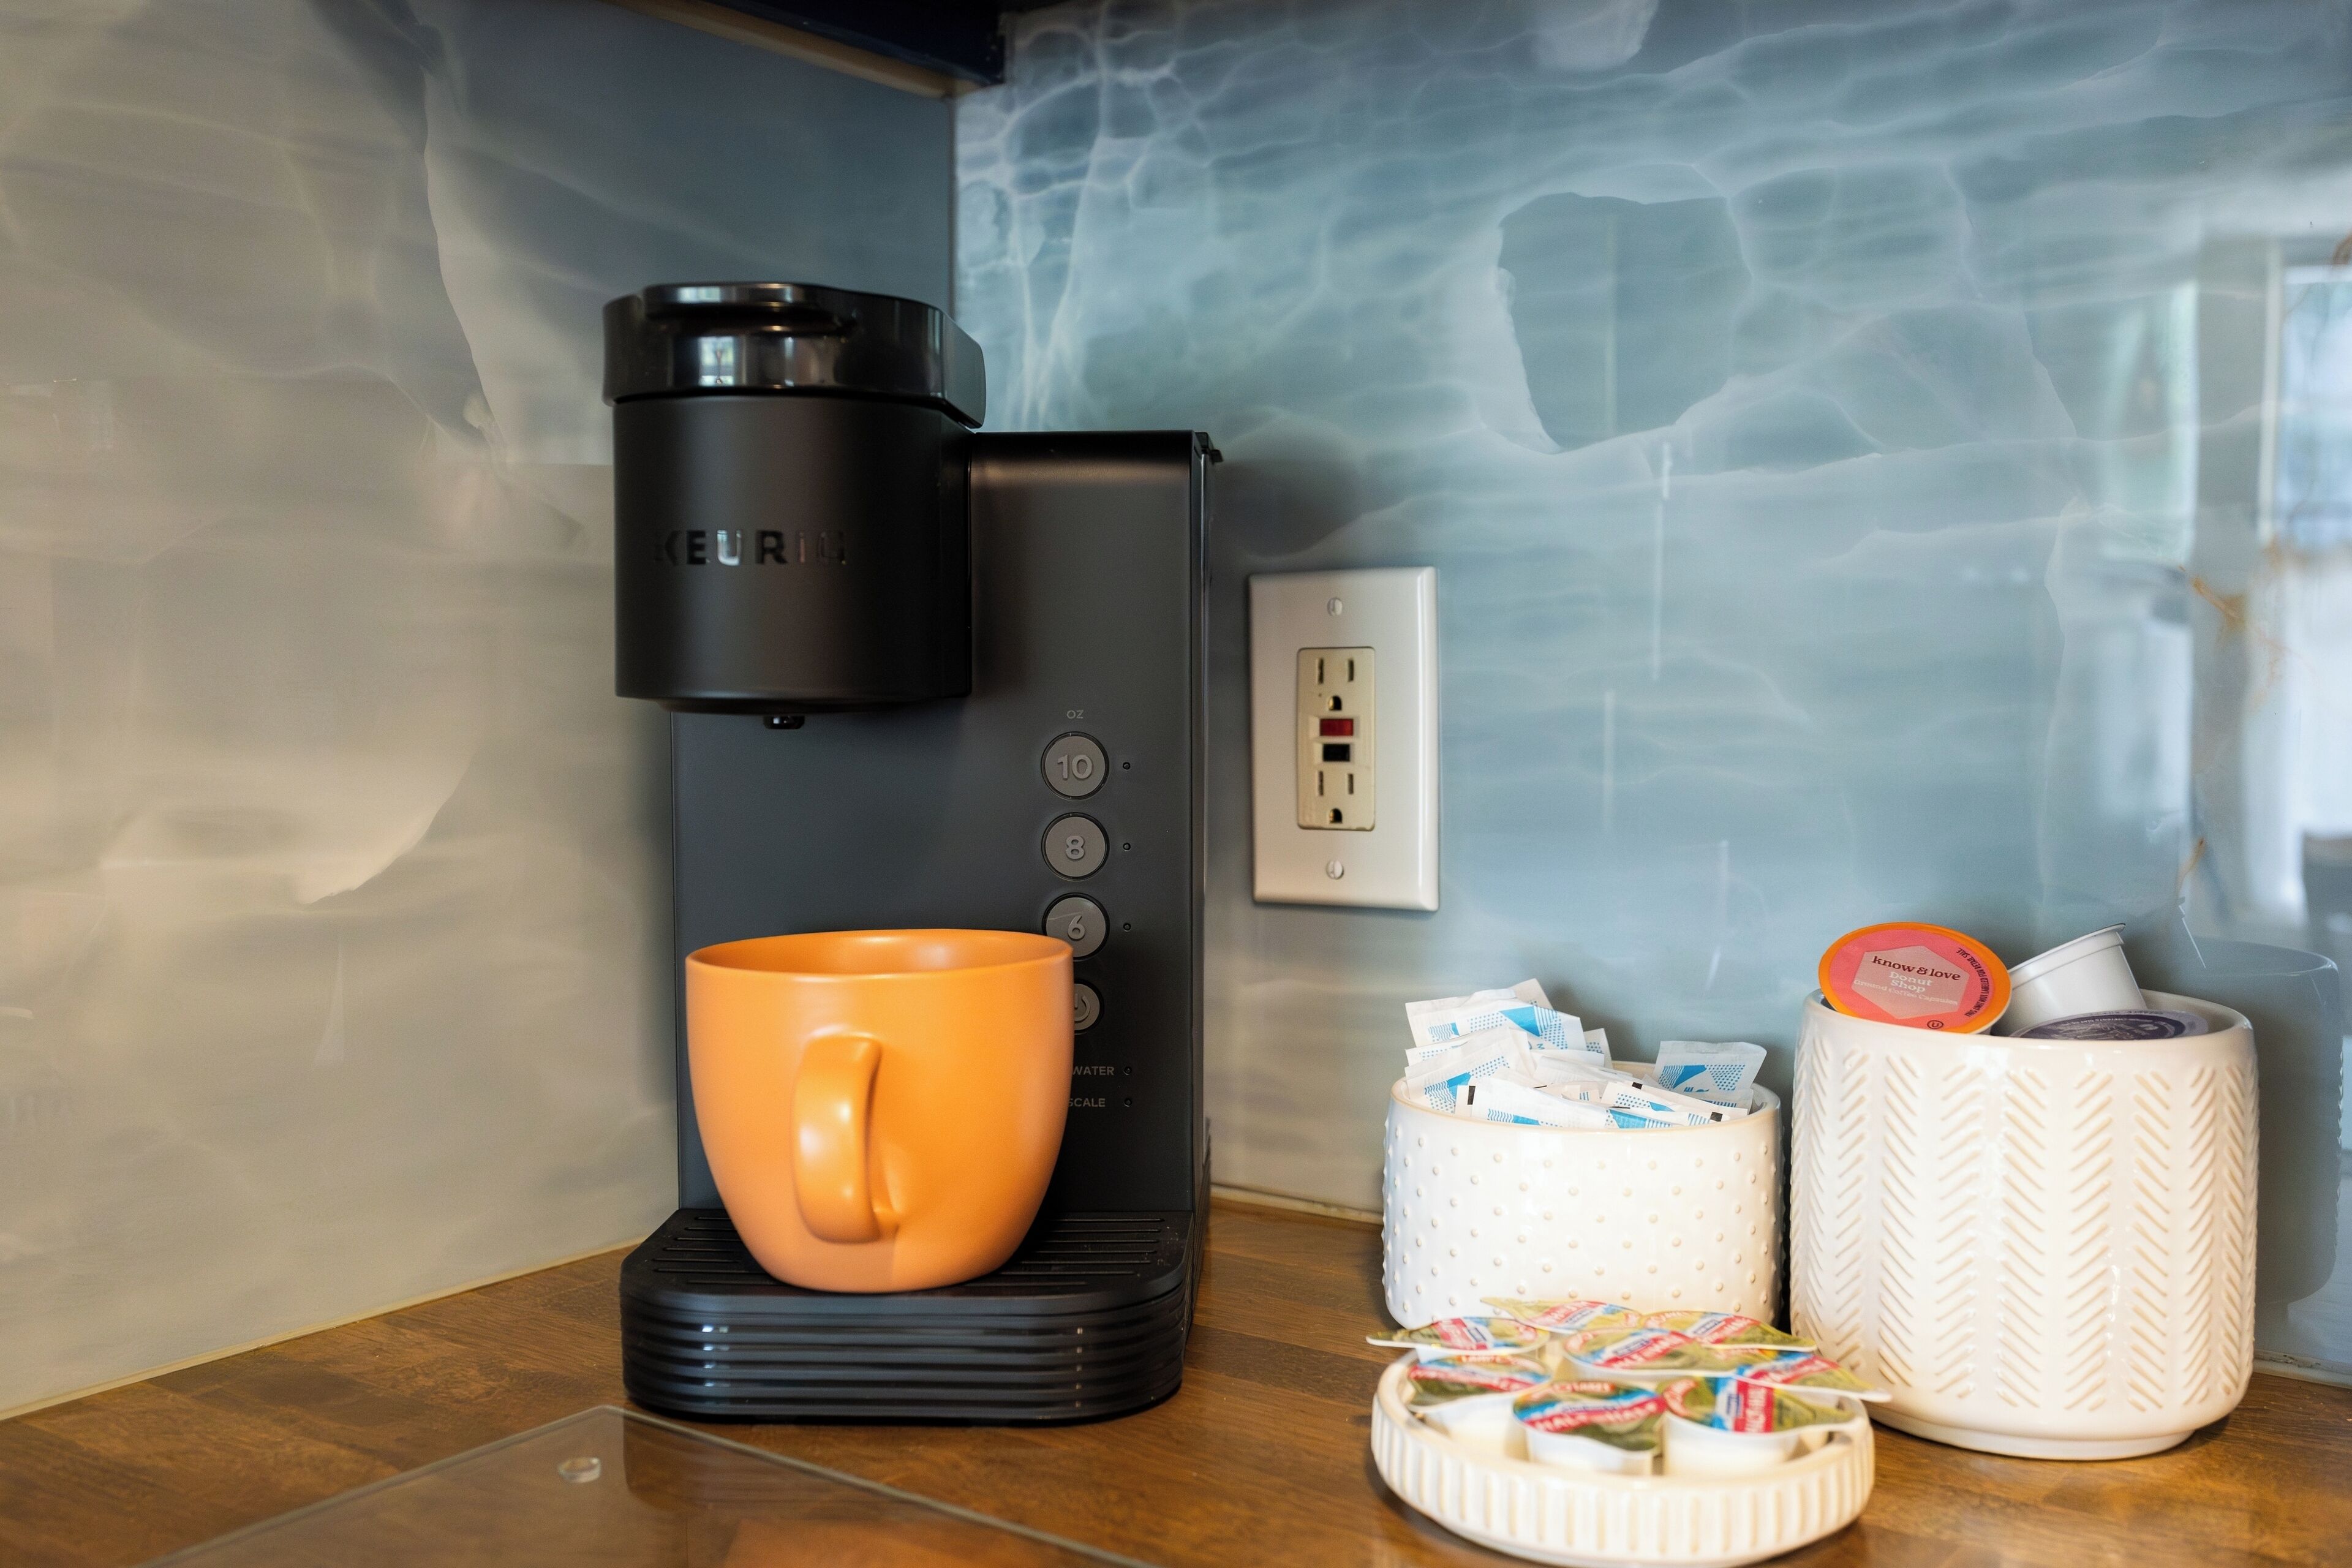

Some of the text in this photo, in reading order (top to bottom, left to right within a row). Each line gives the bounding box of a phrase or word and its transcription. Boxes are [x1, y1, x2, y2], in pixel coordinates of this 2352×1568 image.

[1066, 709, 1084, 719] OZ
[1057, 754, 1093, 780] 10
[1065, 835, 1085, 859] 8
[1067, 914, 1085, 940] 6
[1871, 956, 1961, 981] know & love
[1889, 971, 1934, 986] Donut
[1853, 979, 1958, 1005] Ground Coffee Capsules
[1890, 979, 1926, 993] Shop
[1956, 948, 1989, 1017] THIS UNIT NOT LABELED FOR RETAIL SALE
